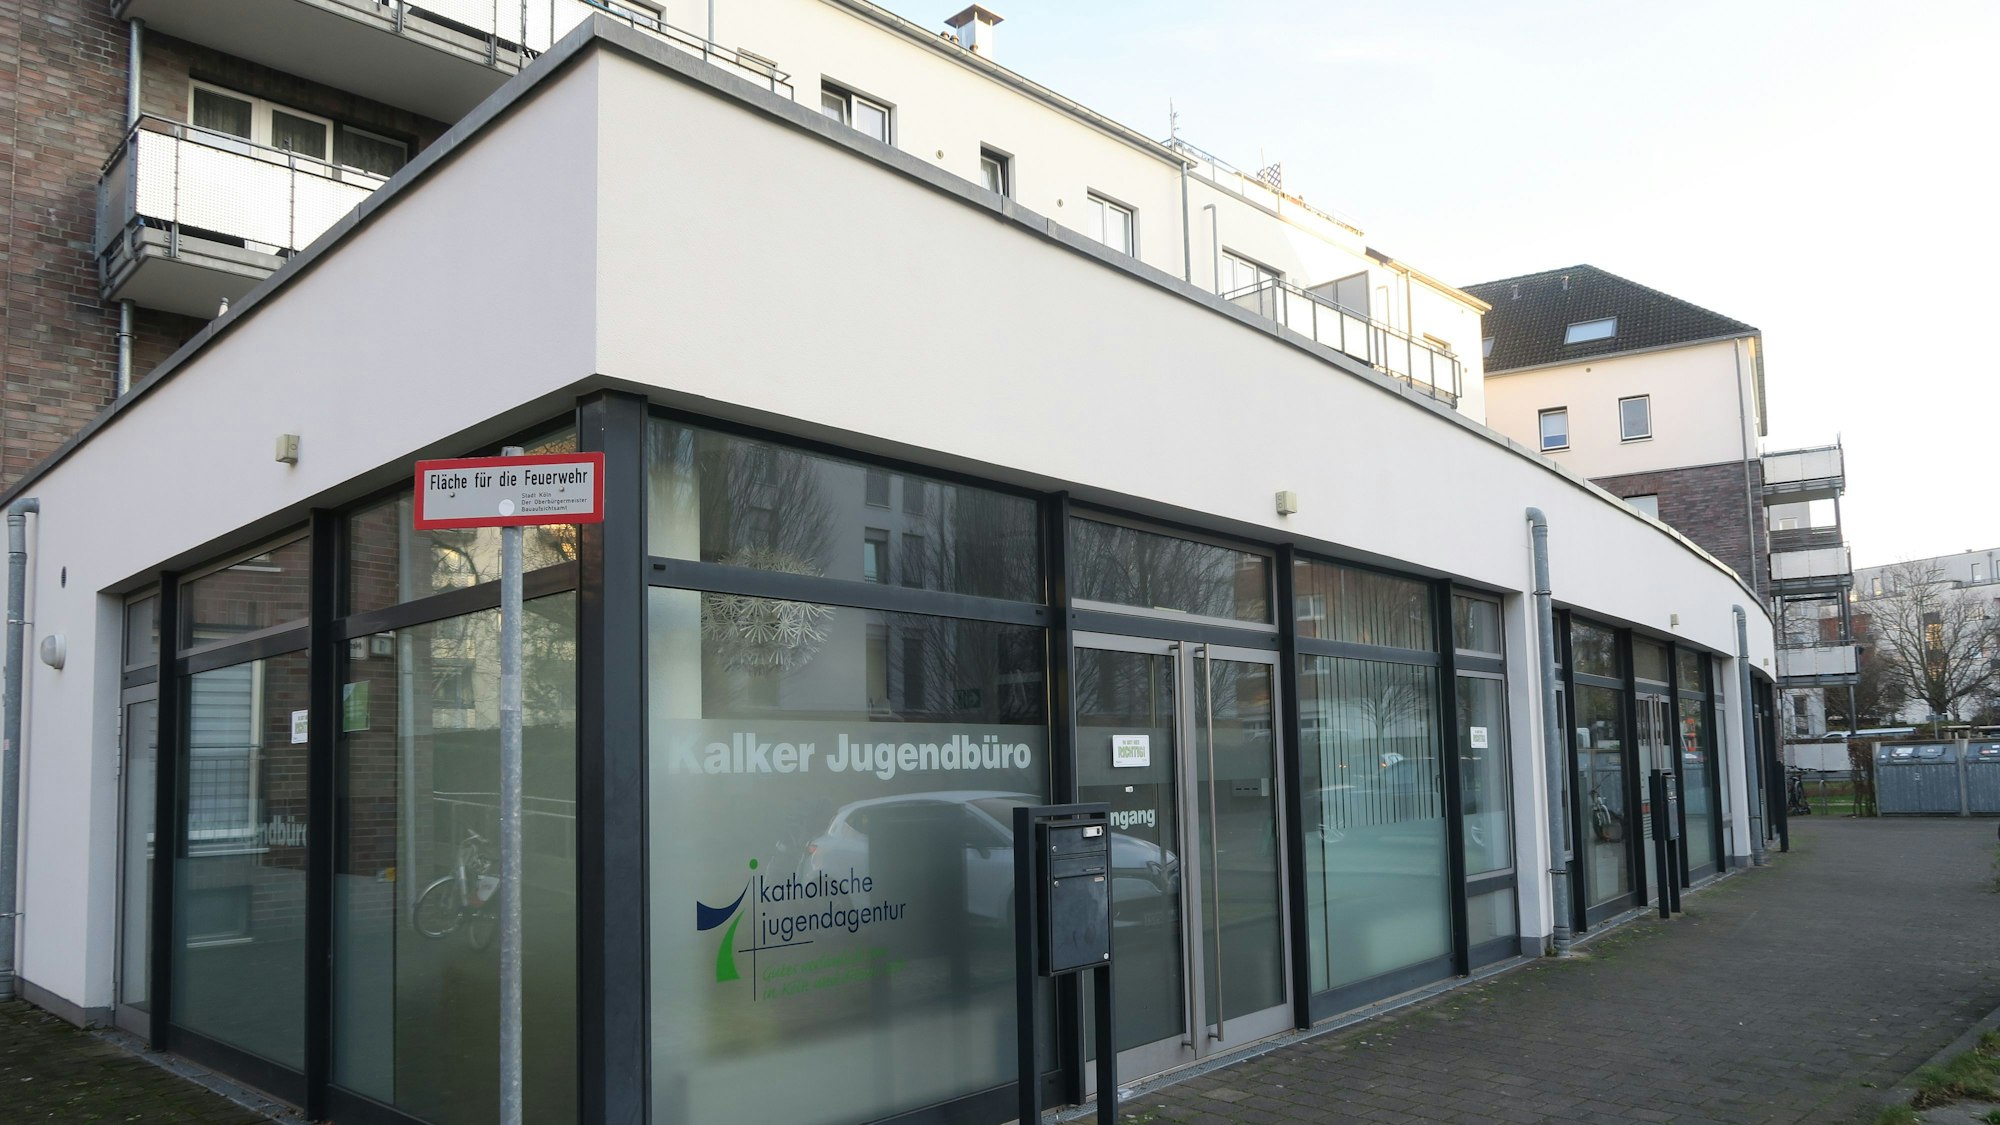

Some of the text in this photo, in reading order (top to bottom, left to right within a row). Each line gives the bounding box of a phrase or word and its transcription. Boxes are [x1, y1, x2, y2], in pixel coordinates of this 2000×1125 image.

[430, 468, 588, 490] Fläche für die Feuerwehr
[668, 733, 1031, 780] Kalker Jugendbüro
[1110, 809, 1155, 830] ngang
[760, 867, 873, 903] katholische
[762, 900, 906, 945] jugendagentur
